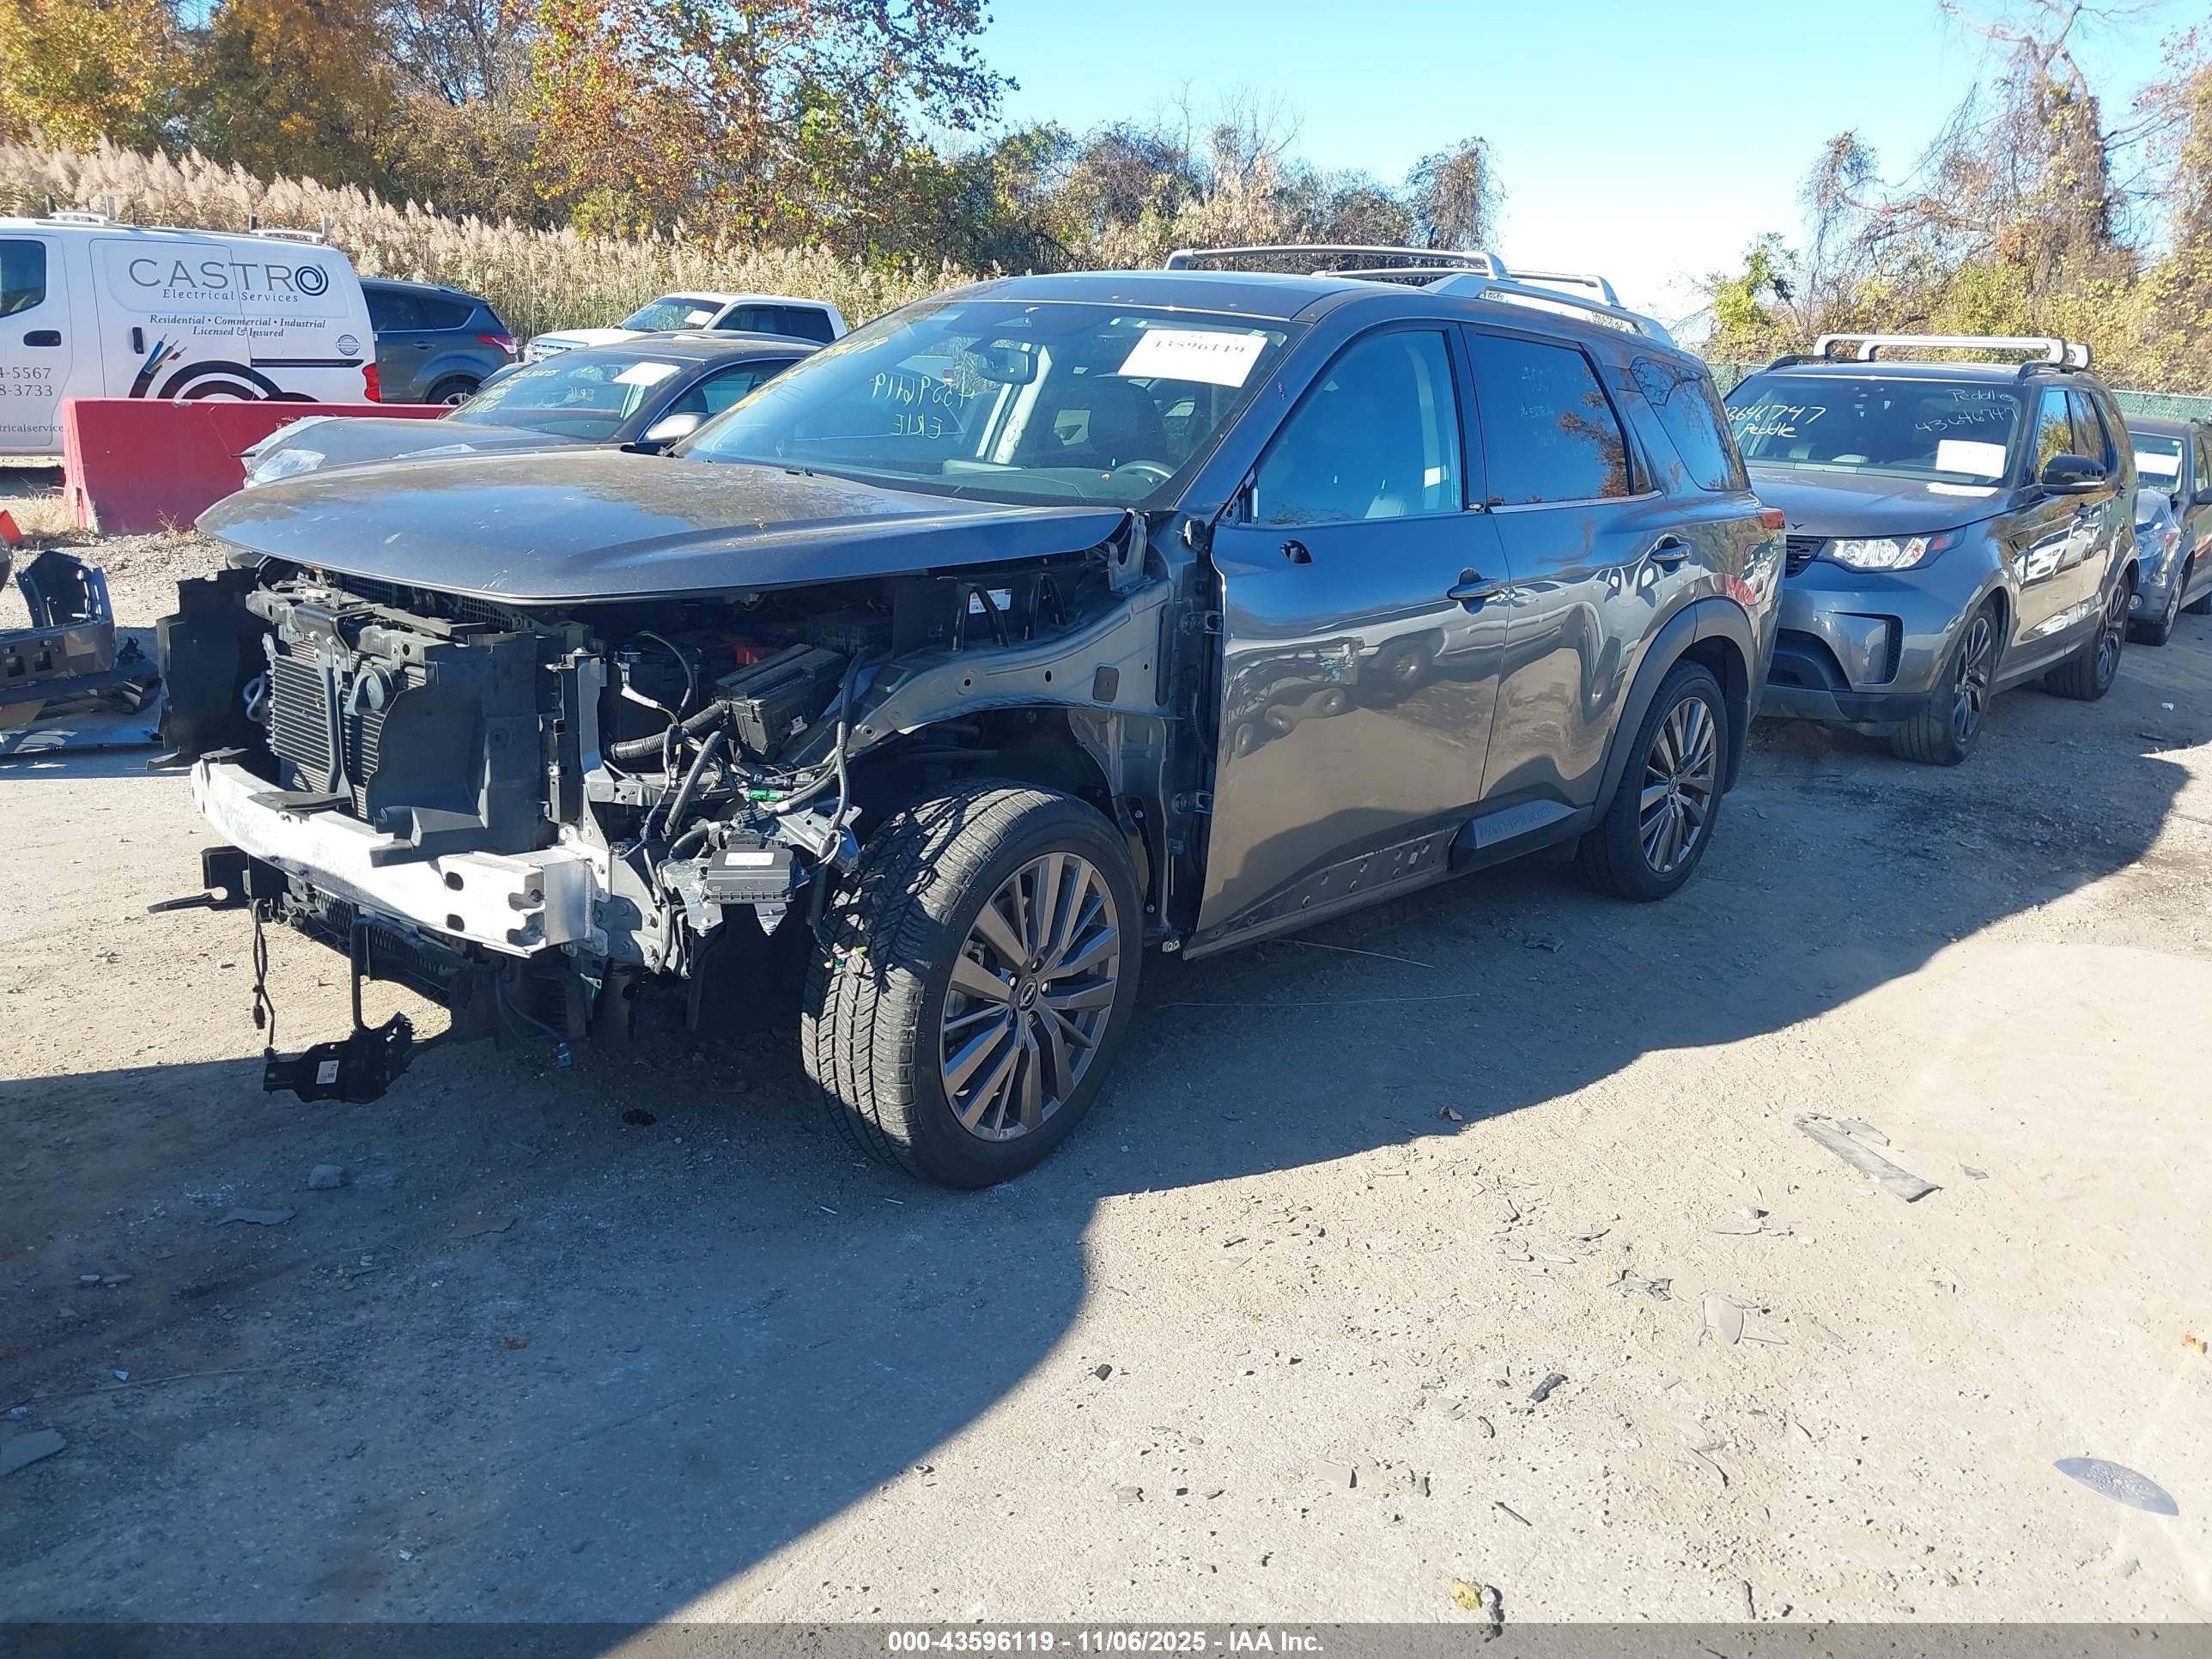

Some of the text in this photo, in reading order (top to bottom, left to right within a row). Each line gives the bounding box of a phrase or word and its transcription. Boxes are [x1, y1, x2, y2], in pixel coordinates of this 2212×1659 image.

[129, 258, 329, 296] CASTRO
[162, 289, 299, 303] Electrical Services
[149, 314, 326, 329] Residential Commercial Industrial
[192, 325, 284, 337] Licensed & Insured
[1944, 388, 2014, 403] Peddle
[1915, 407, 2019, 432] 43646747
[1736, 422, 1799, 441] Peddle
